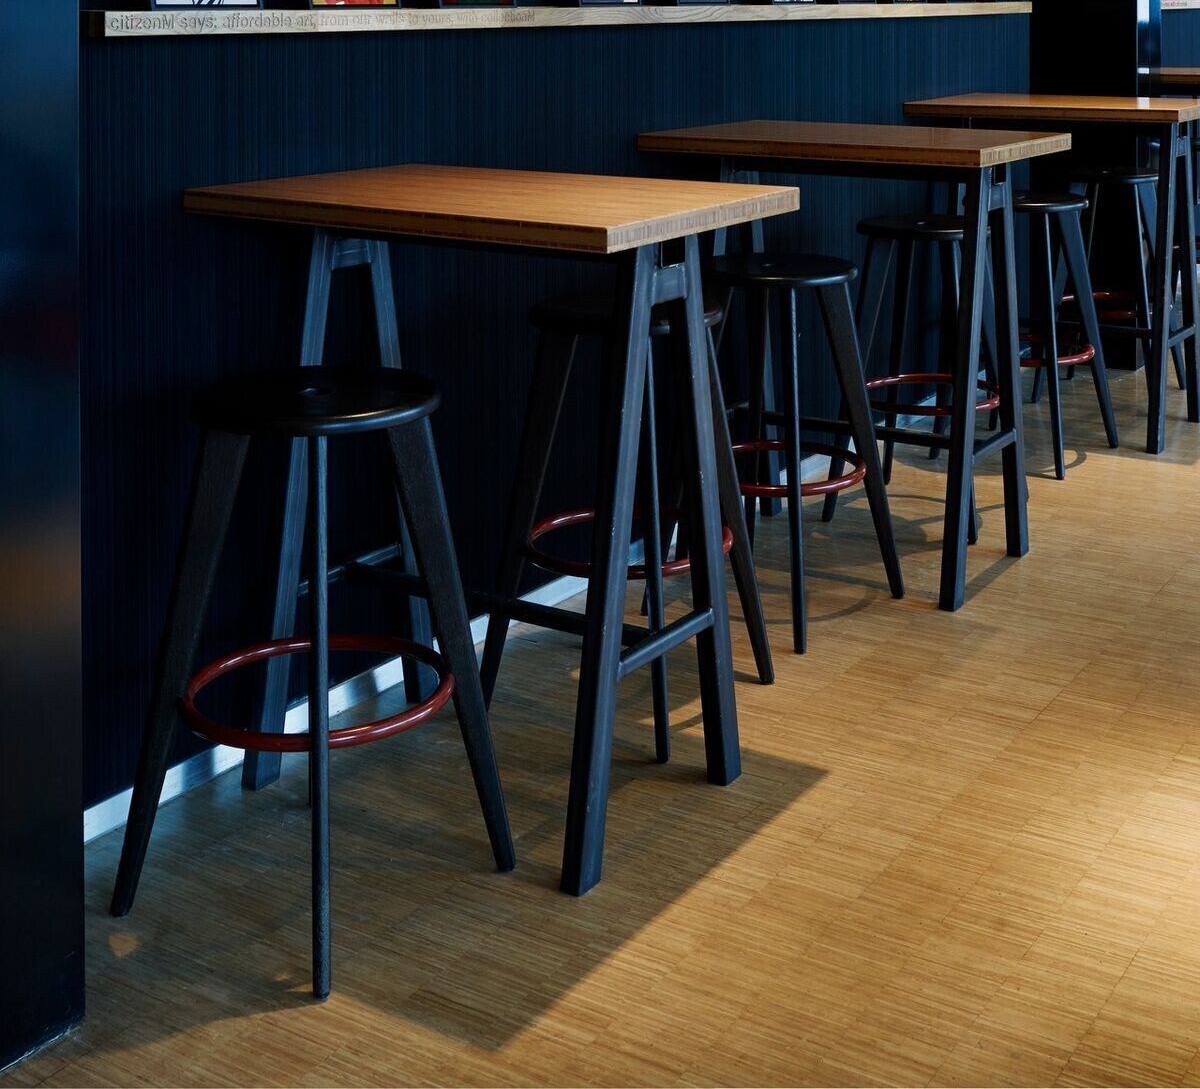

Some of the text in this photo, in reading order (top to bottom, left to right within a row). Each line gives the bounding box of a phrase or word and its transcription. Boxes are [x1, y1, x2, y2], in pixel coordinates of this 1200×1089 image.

[110, 14, 175, 30] citizenM
[180, 14, 217, 32] says:
[223, 12, 292, 29] affordable
[296, 14, 318, 30] art,
[319, 13, 349, 27] from
[352, 15, 371, 26] our
[374, 11, 404, 26] walls
[408, 12, 419, 25] to
